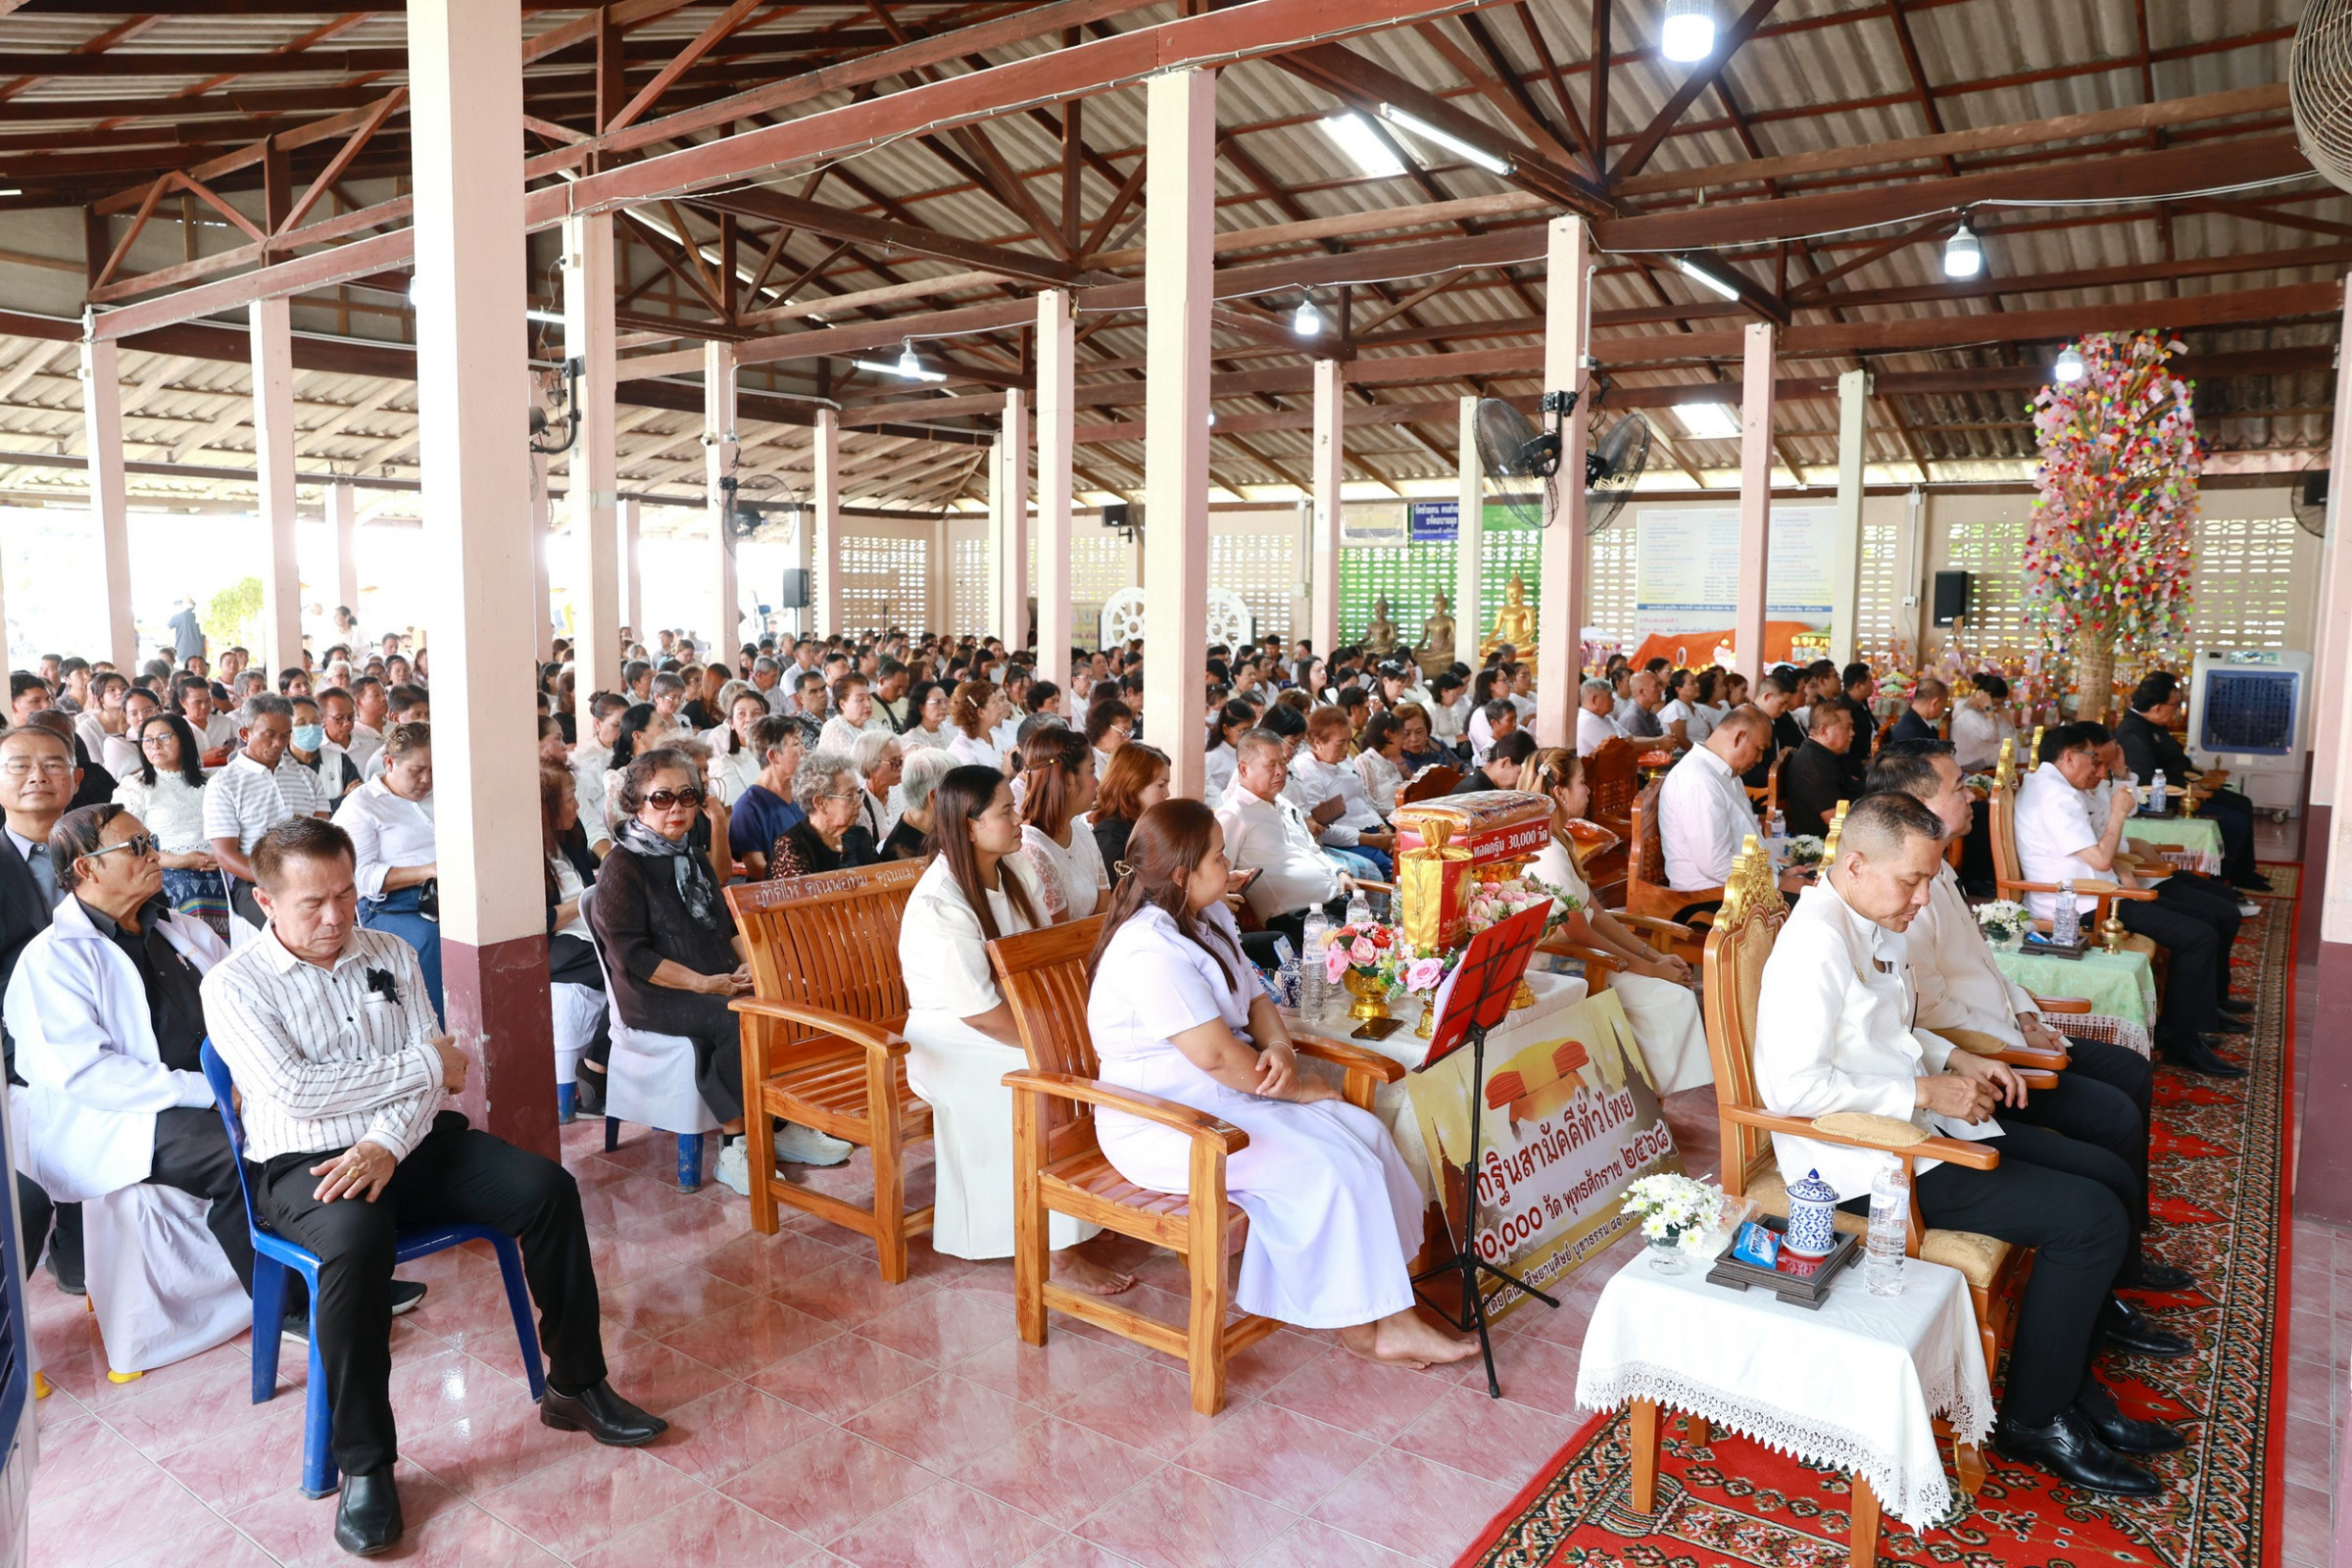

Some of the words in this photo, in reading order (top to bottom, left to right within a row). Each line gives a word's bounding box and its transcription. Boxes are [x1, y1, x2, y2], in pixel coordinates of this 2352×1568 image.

[1507, 829, 1537, 850] 30,000
[1537, 825, 1547, 842] วัด
[1477, 1092, 1635, 1206] กฐินสามัคคีทั่วไทย
[1543, 1193, 1563, 1220] วัด
[1563, 1159, 1624, 1216] พุทธศักราช
[1620, 1124, 1670, 1170] ๒๕๖๘
[1506, 1243, 1572, 1302] คณศิษยานุศิษย์
[1573, 1224, 1610, 1261] บูชาธรรม
